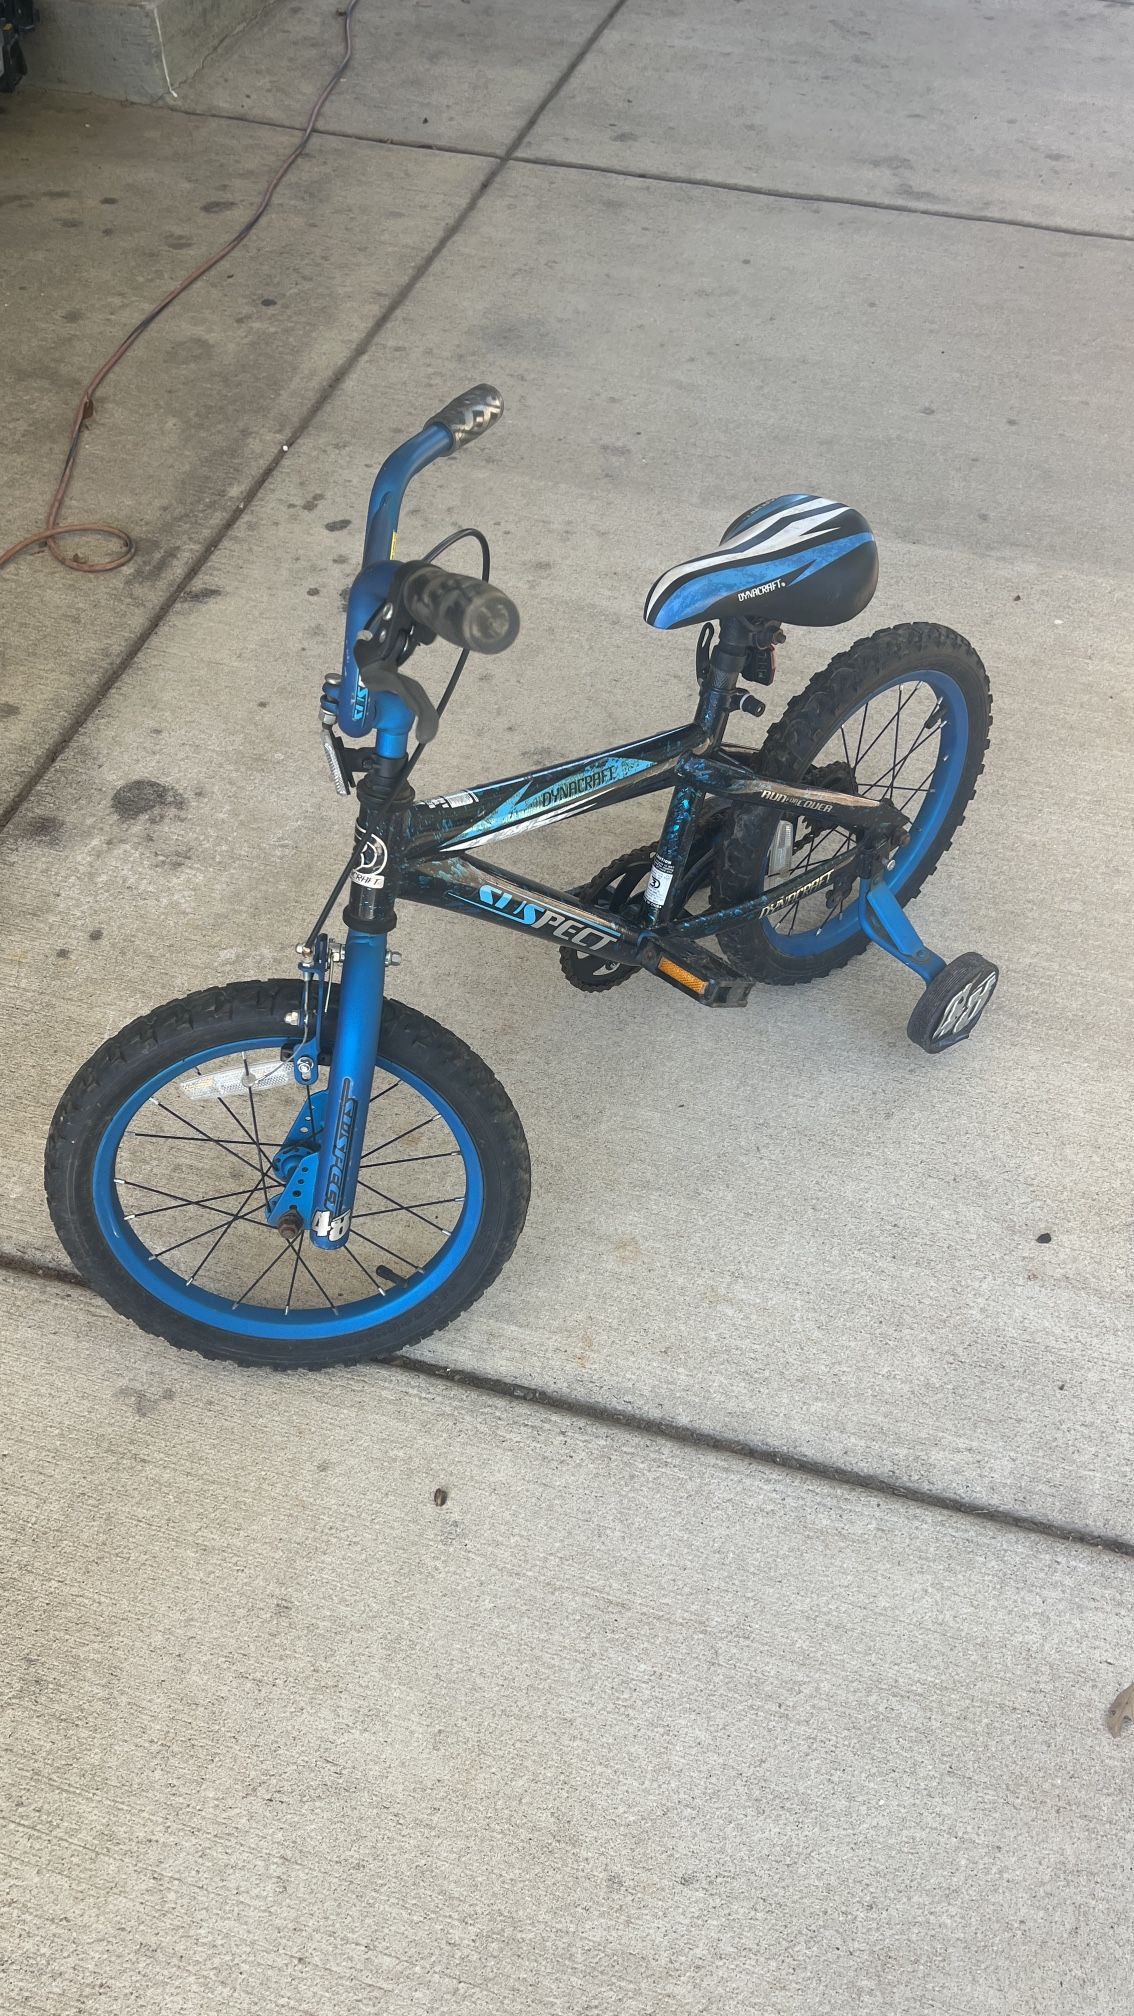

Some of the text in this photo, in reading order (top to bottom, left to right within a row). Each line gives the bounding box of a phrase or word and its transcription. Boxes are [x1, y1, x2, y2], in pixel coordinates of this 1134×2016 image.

[738, 579, 781, 601] DYNACRAFT
[541, 765, 615, 807] DYNACRAFT
[761, 790, 787, 803] RUN
[797, 800, 833, 812] COVER
[479, 884, 618, 951] SUSPECT
